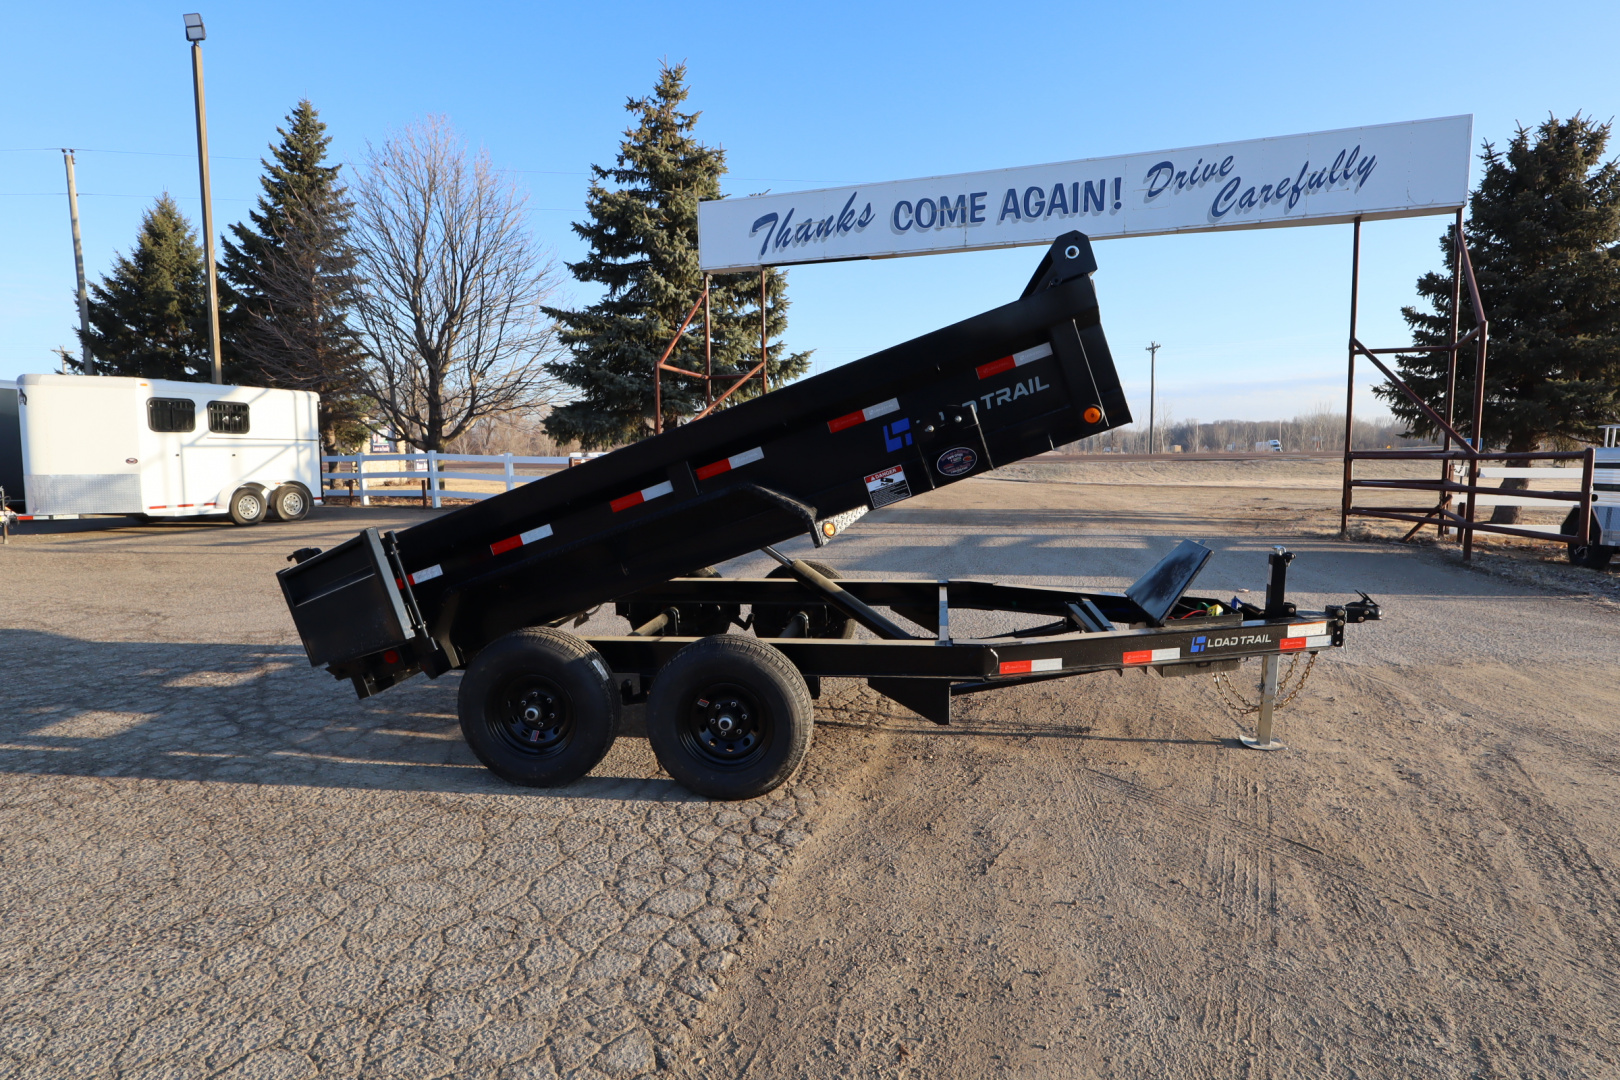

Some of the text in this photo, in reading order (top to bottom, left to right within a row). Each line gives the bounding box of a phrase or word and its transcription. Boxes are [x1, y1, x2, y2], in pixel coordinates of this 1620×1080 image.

[1146, 155, 1235, 198] Drive
[1211, 144, 1378, 218] Carefully
[751, 176, 1122, 256] Thanks COME AGAIN!
[980, 376, 1050, 410] TRAIL
[875, 468, 897, 479] DANGER
[1207, 636, 1239, 648] LOAD
[1240, 634, 1272, 645] TRAIL
